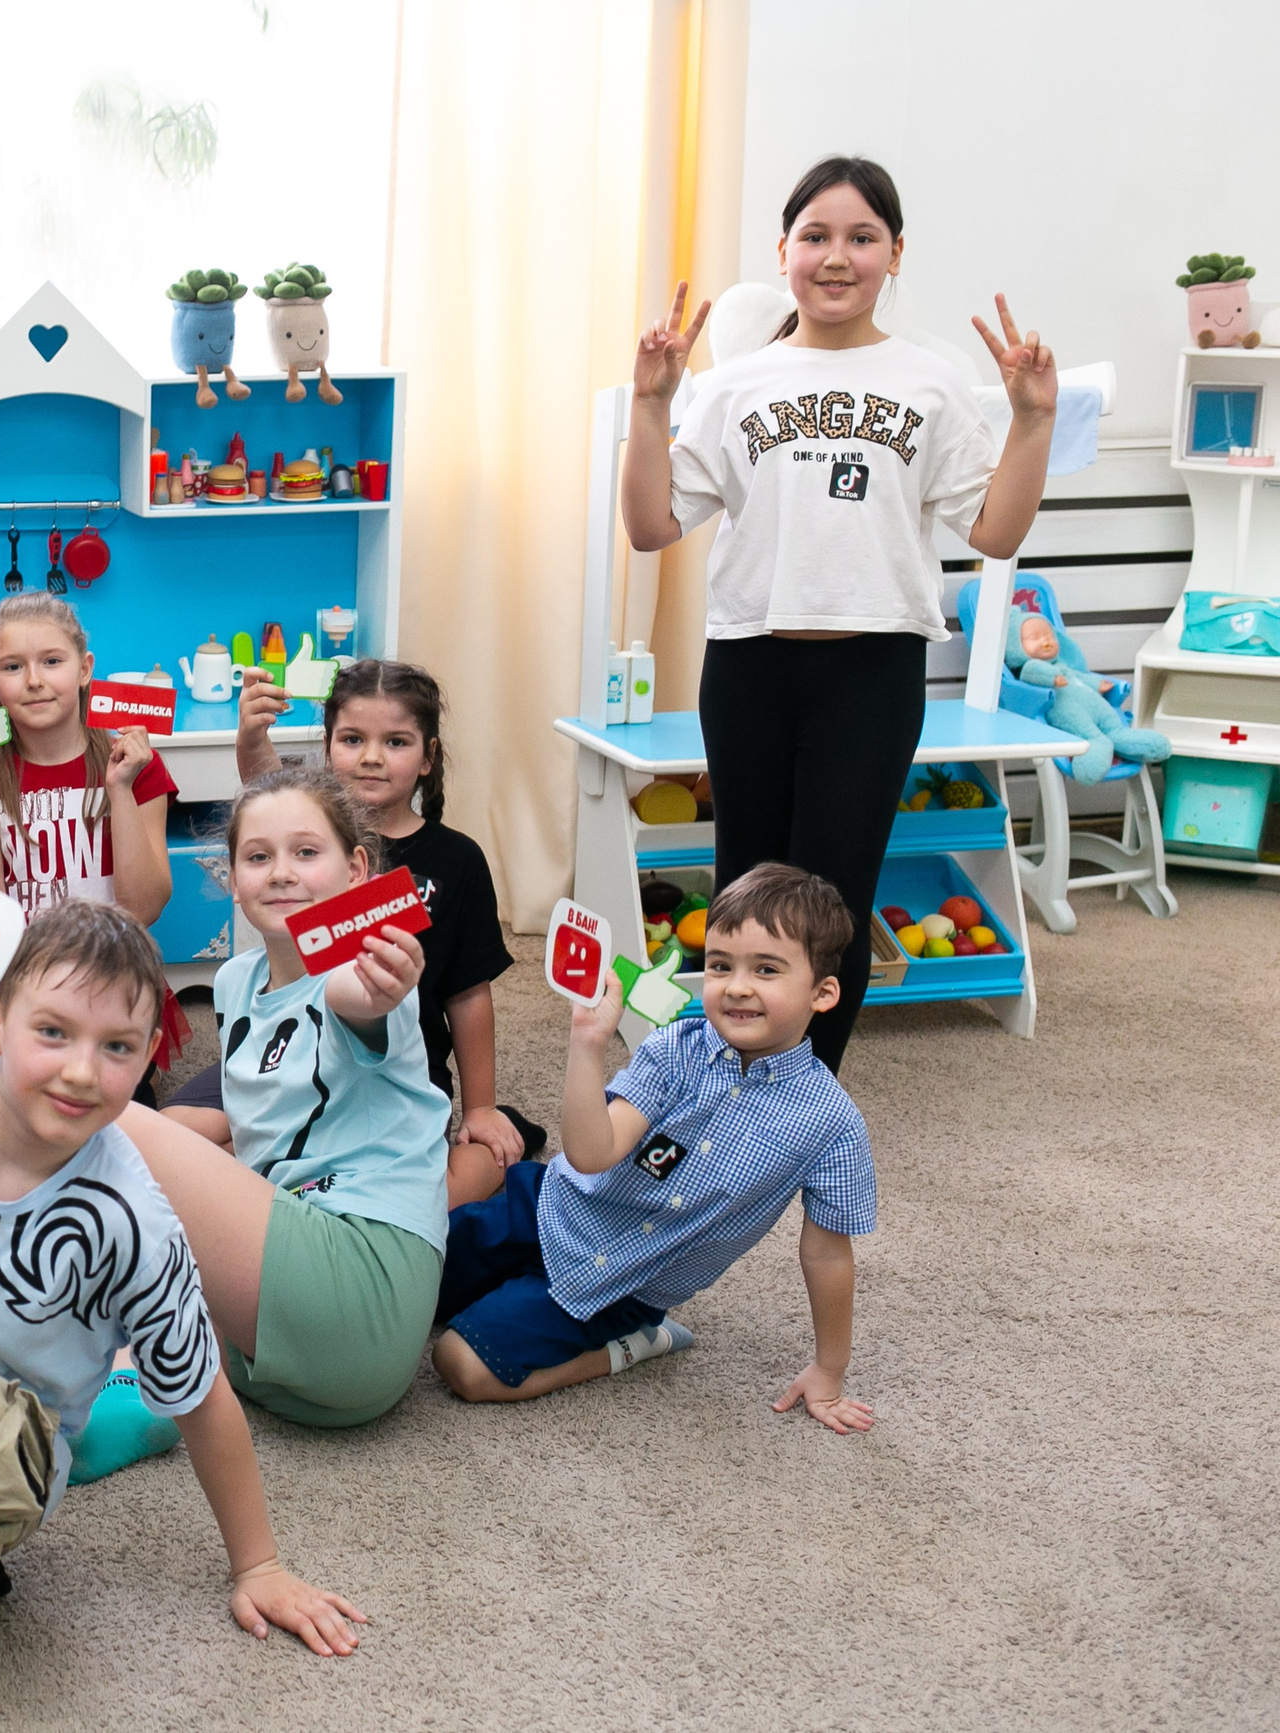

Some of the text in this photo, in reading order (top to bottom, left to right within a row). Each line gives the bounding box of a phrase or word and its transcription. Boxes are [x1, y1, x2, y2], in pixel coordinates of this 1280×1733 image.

[740, 391, 924, 466] ANGEL
[793, 451, 863, 463] ONE OF A KIND
[835, 489, 859, 499] TikTok
[114, 701, 173, 717] ПОДПИСКА
[0, 817, 104, 882] NOW
[331, 892, 419, 939] ПОДПИСКА
[575, 911, 598, 935] БАН!
[640, 1158, 662, 1178] TikTok
